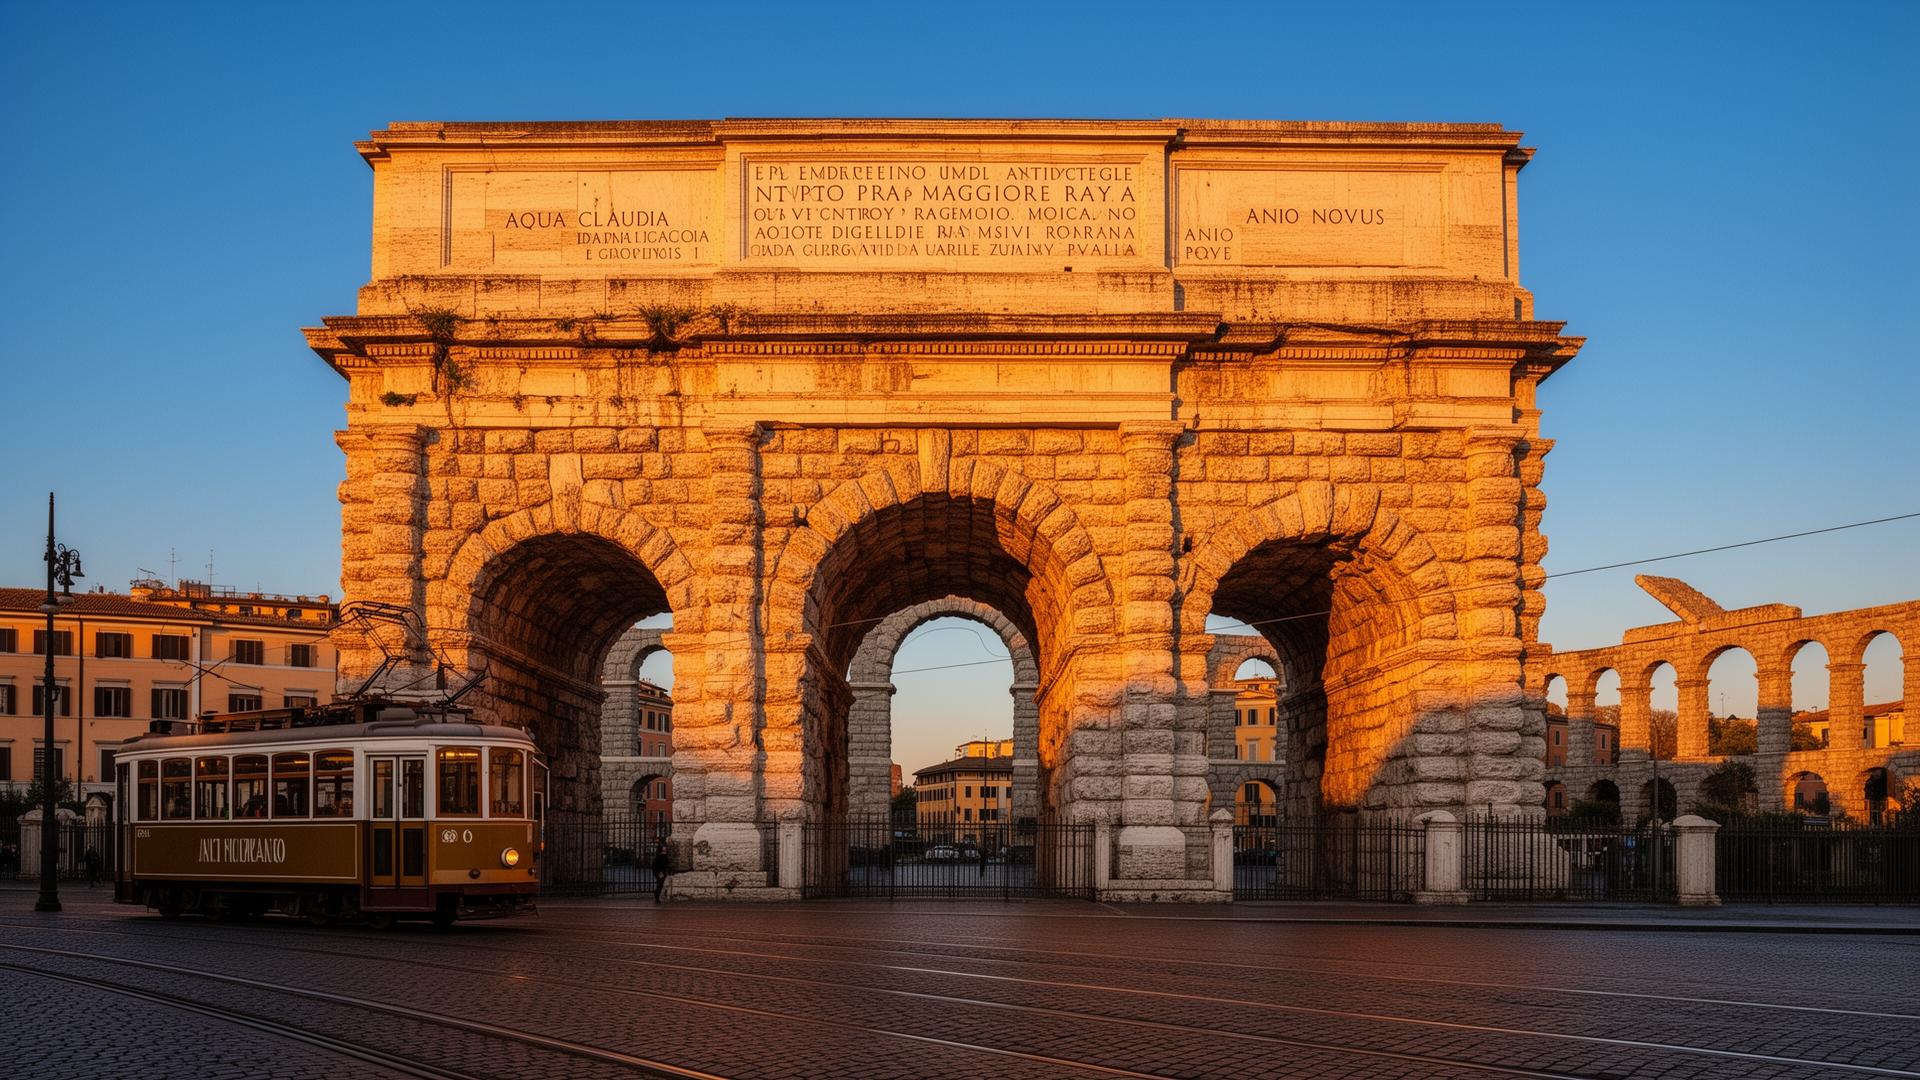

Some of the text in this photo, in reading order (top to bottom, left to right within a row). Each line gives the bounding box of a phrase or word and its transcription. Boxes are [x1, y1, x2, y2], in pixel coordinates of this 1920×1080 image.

[923, 184, 1050, 202] MAGGIORE
[505, 209, 669, 231] AQUA CLAUDIA
[1246, 207, 1385, 225] ANIO NOVUS
[1184, 227, 1234, 242] ANIO
